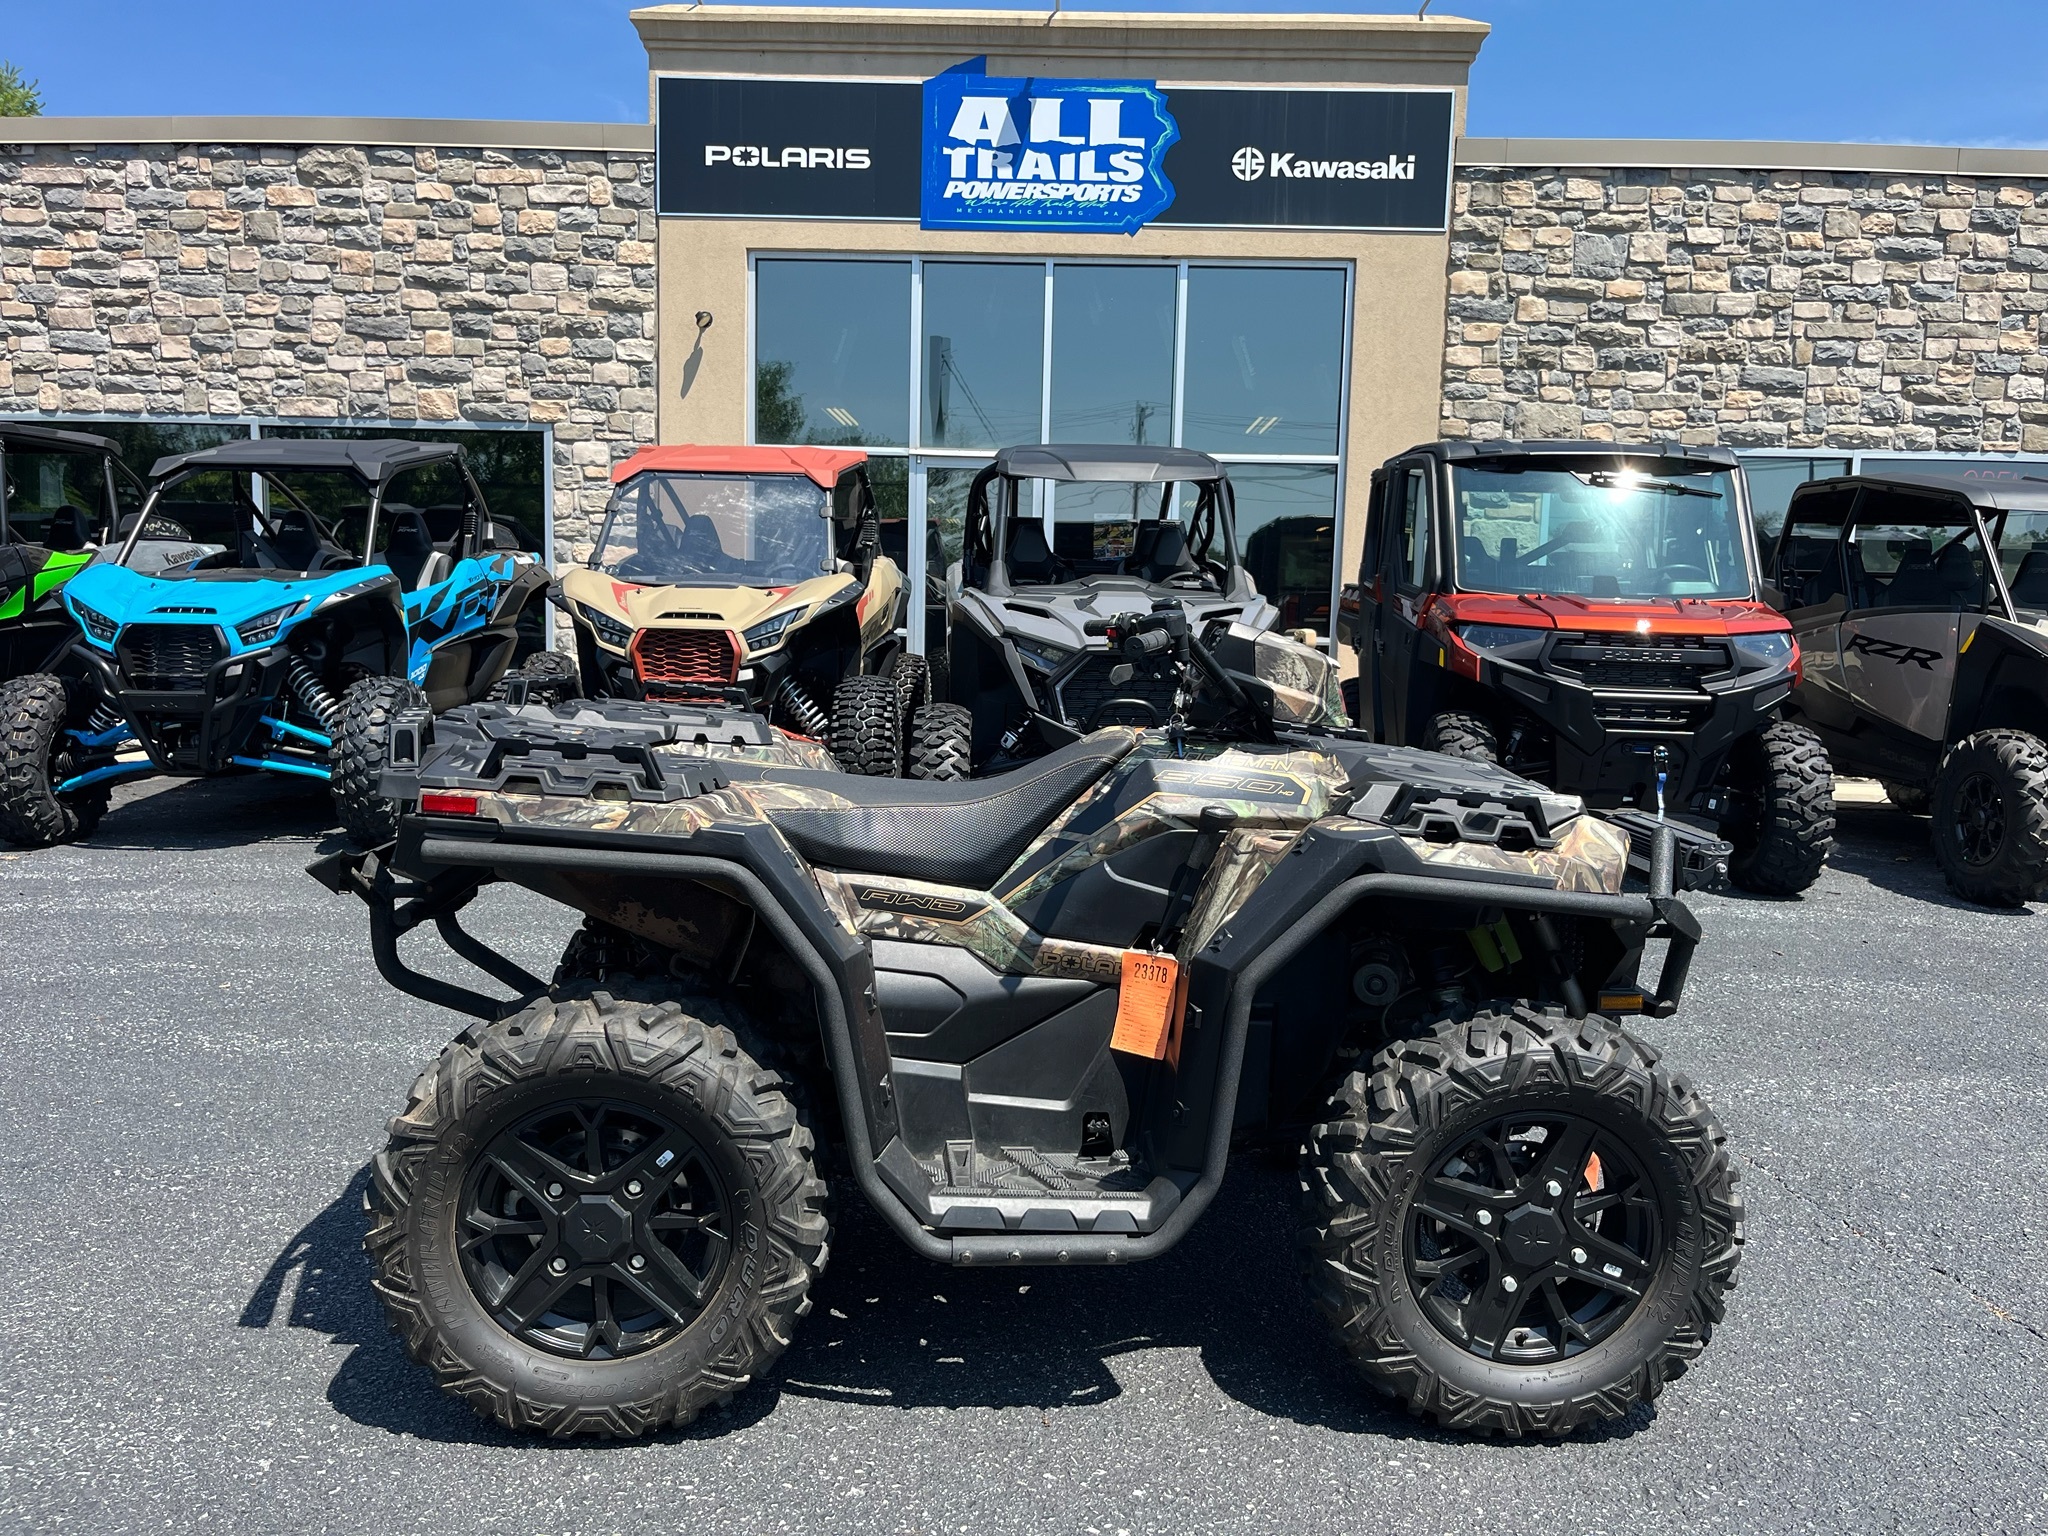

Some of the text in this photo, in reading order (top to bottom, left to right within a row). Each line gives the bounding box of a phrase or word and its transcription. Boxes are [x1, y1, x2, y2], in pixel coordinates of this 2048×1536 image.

[948, 96, 1146, 150] ALL
[705, 145, 871, 169] POLARIS
[943, 147, 1144, 182] TRAILS
[1270, 152, 1416, 180] Kawasaki
[943, 181, 1143, 203] POWERSPORTS
[1601, 649, 1682, 663] POLARIS
[1844, 633, 1944, 671] RZR
[1152, 769, 1285, 795] 850
[860, 888, 967, 914] AWD
[1134, 962, 1169, 984] 23378
[709, 1222, 759, 1345] DURO
